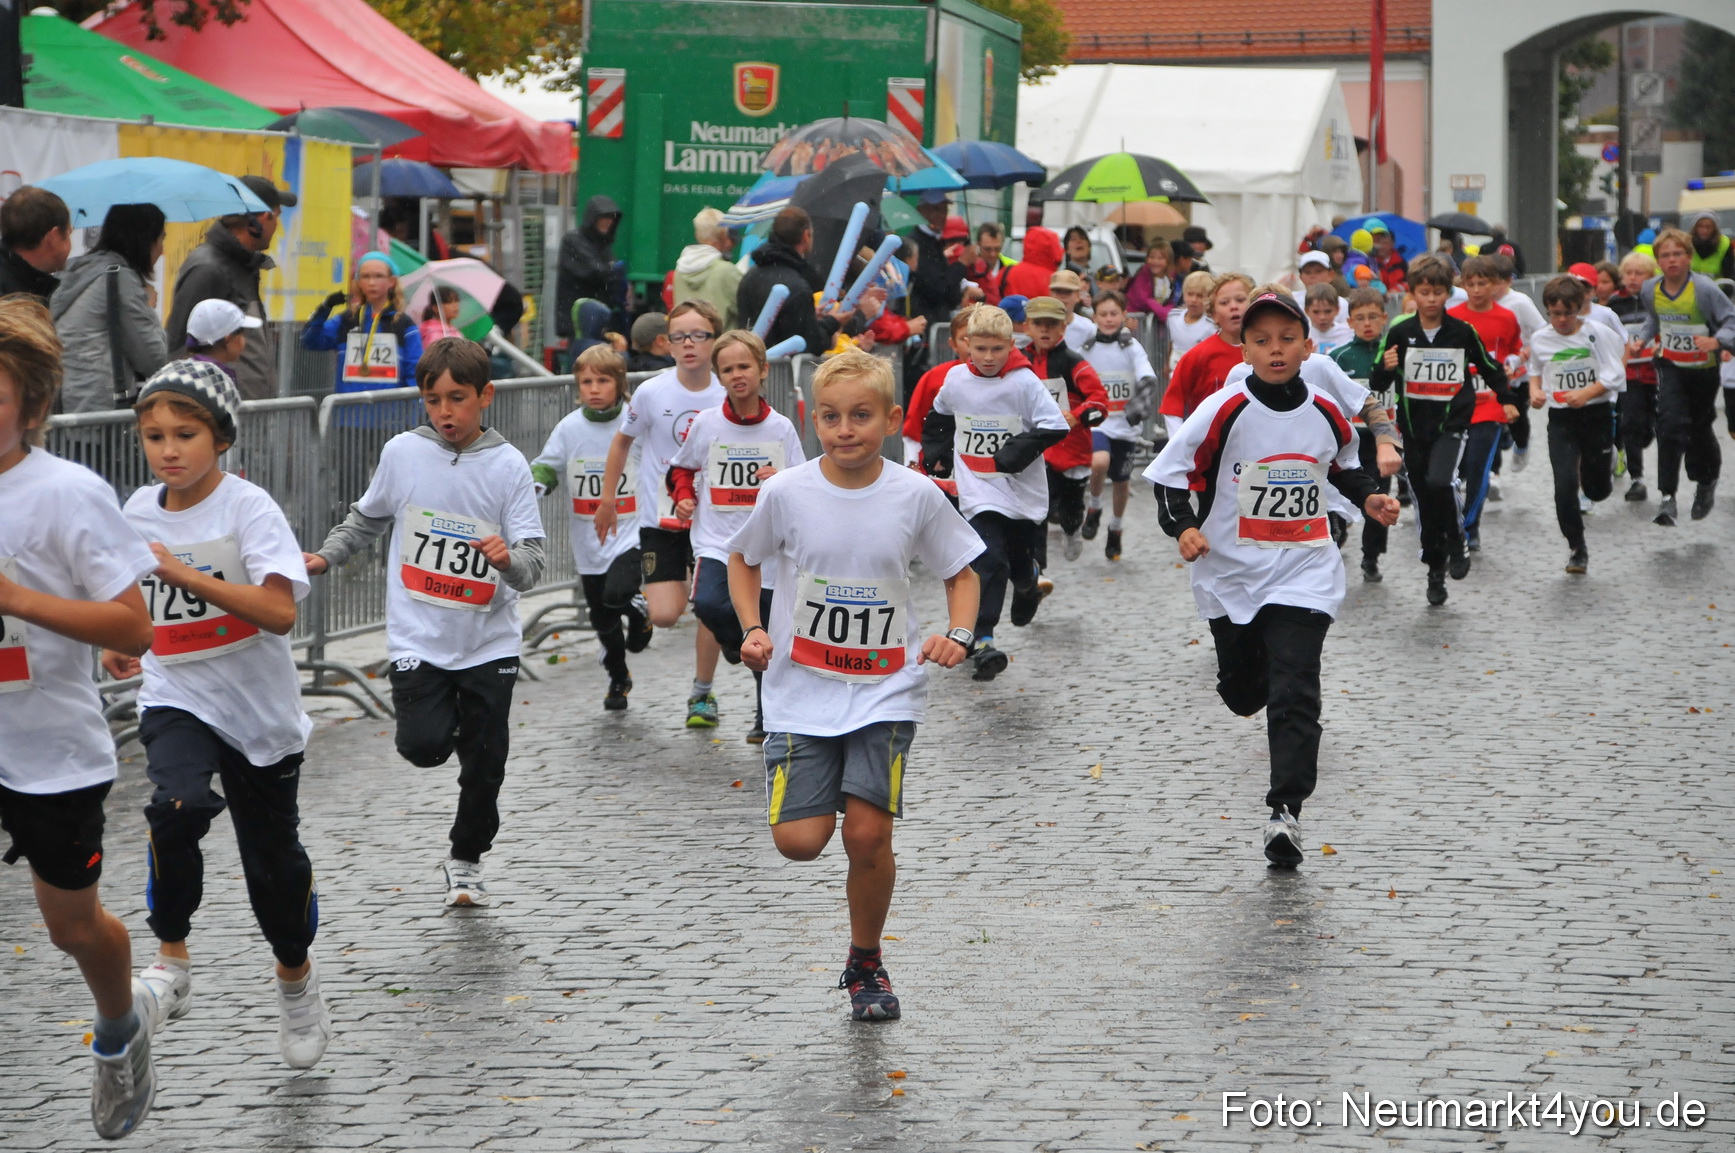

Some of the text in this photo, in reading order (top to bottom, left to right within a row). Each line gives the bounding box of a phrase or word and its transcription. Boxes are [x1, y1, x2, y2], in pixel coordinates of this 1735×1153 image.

[1665, 333, 1699, 351] 723
[351, 346, 392, 364] 742
[1412, 362, 1457, 381] 7102
[1555, 368, 1597, 390] 7094
[727, 447, 760, 456] BOCK
[574, 472, 629, 497] 702
[717, 461, 773, 487] 708
[1268, 469, 1308, 479] BOCK
[1249, 484, 1320, 518] 7238
[431, 517, 476, 535] BOCK
[413, 531, 489, 579] 7130
[141, 571, 226, 621] 729
[424, 576, 466, 598] David
[825, 585, 878, 599] BOCK
[806, 600, 895, 646] 7017
[825, 650, 873, 671] Lukas
